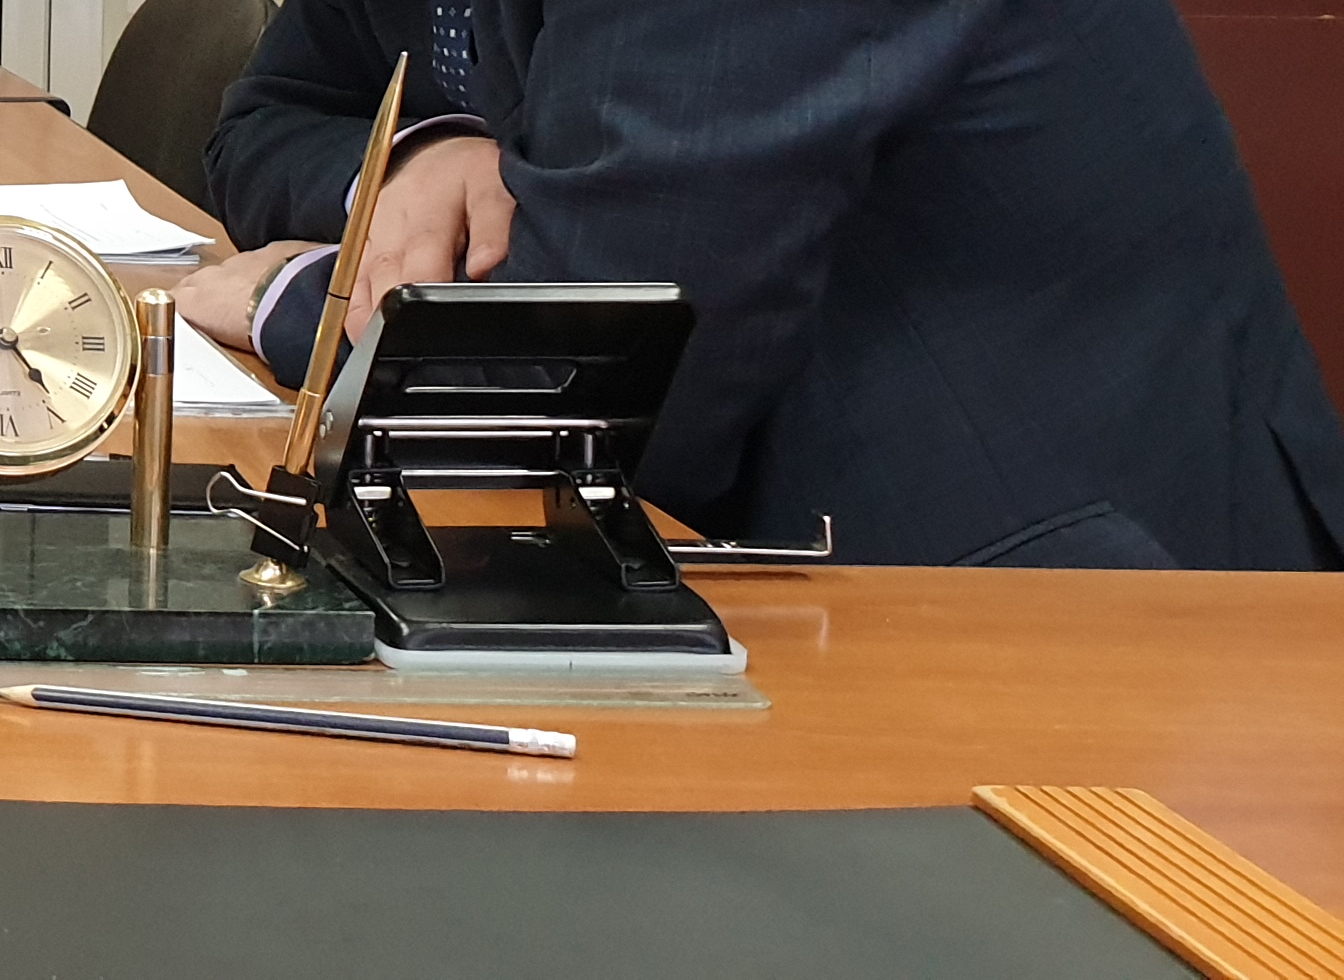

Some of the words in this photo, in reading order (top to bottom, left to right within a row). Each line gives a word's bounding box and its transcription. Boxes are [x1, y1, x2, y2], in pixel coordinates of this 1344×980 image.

[40, 260, 53, 279] I
[68, 292, 92, 311] II
[82, 336, 105, 352] III
[69, 372, 97, 399] IIII
[0, 413, 20, 437] VI
[46, 406, 66, 430] V
